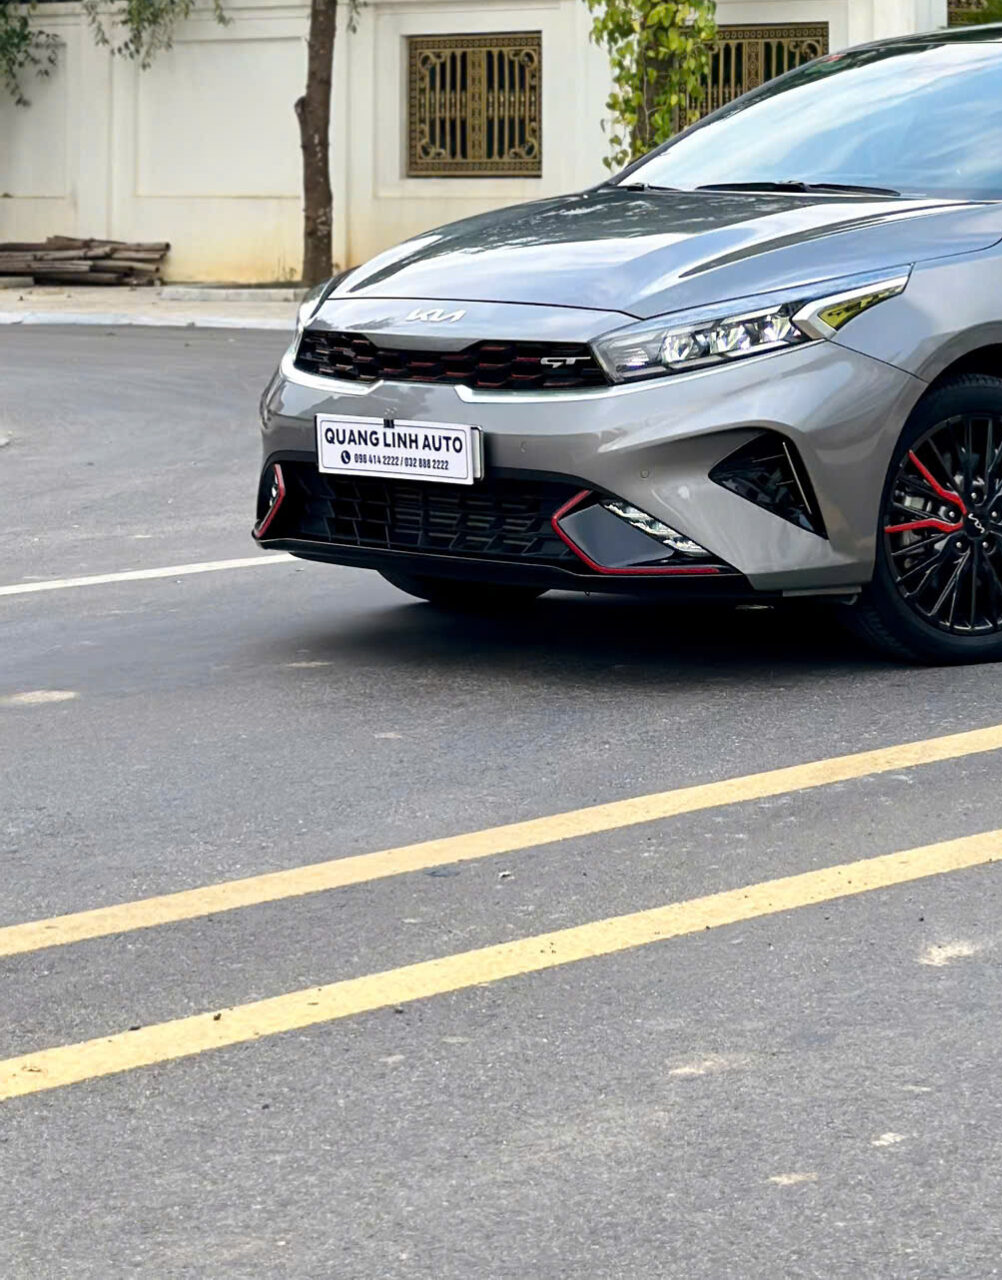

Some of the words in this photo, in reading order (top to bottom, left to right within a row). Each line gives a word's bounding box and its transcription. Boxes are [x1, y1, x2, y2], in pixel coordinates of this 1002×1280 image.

[540, 356, 591, 368] GT
[324, 427, 380, 447] QUANG
[383, 431, 419, 450] LINH
[422, 434, 463, 454] AUTO
[369, 454, 381, 465] 414
[382, 455, 399, 466] 2222
[404, 456, 417, 467] 032
[432, 459, 449, 470] 2222
